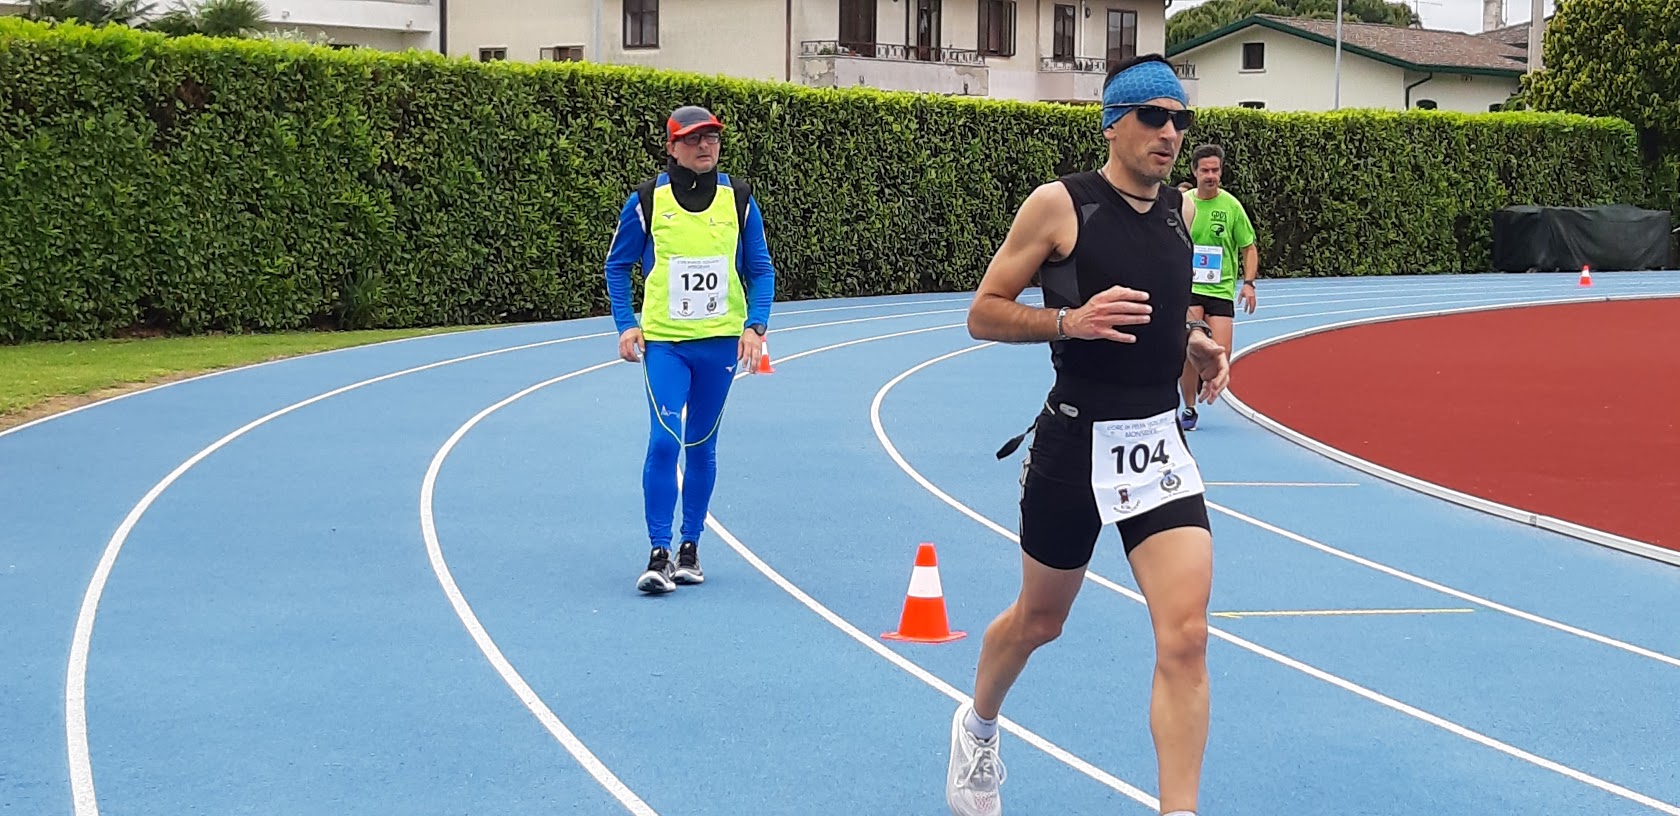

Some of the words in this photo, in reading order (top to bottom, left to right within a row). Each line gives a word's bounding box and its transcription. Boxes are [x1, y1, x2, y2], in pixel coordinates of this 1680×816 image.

[1200, 255, 1208, 266] 3
[681, 272, 718, 291] 120
[1111, 439, 1170, 474] 104
